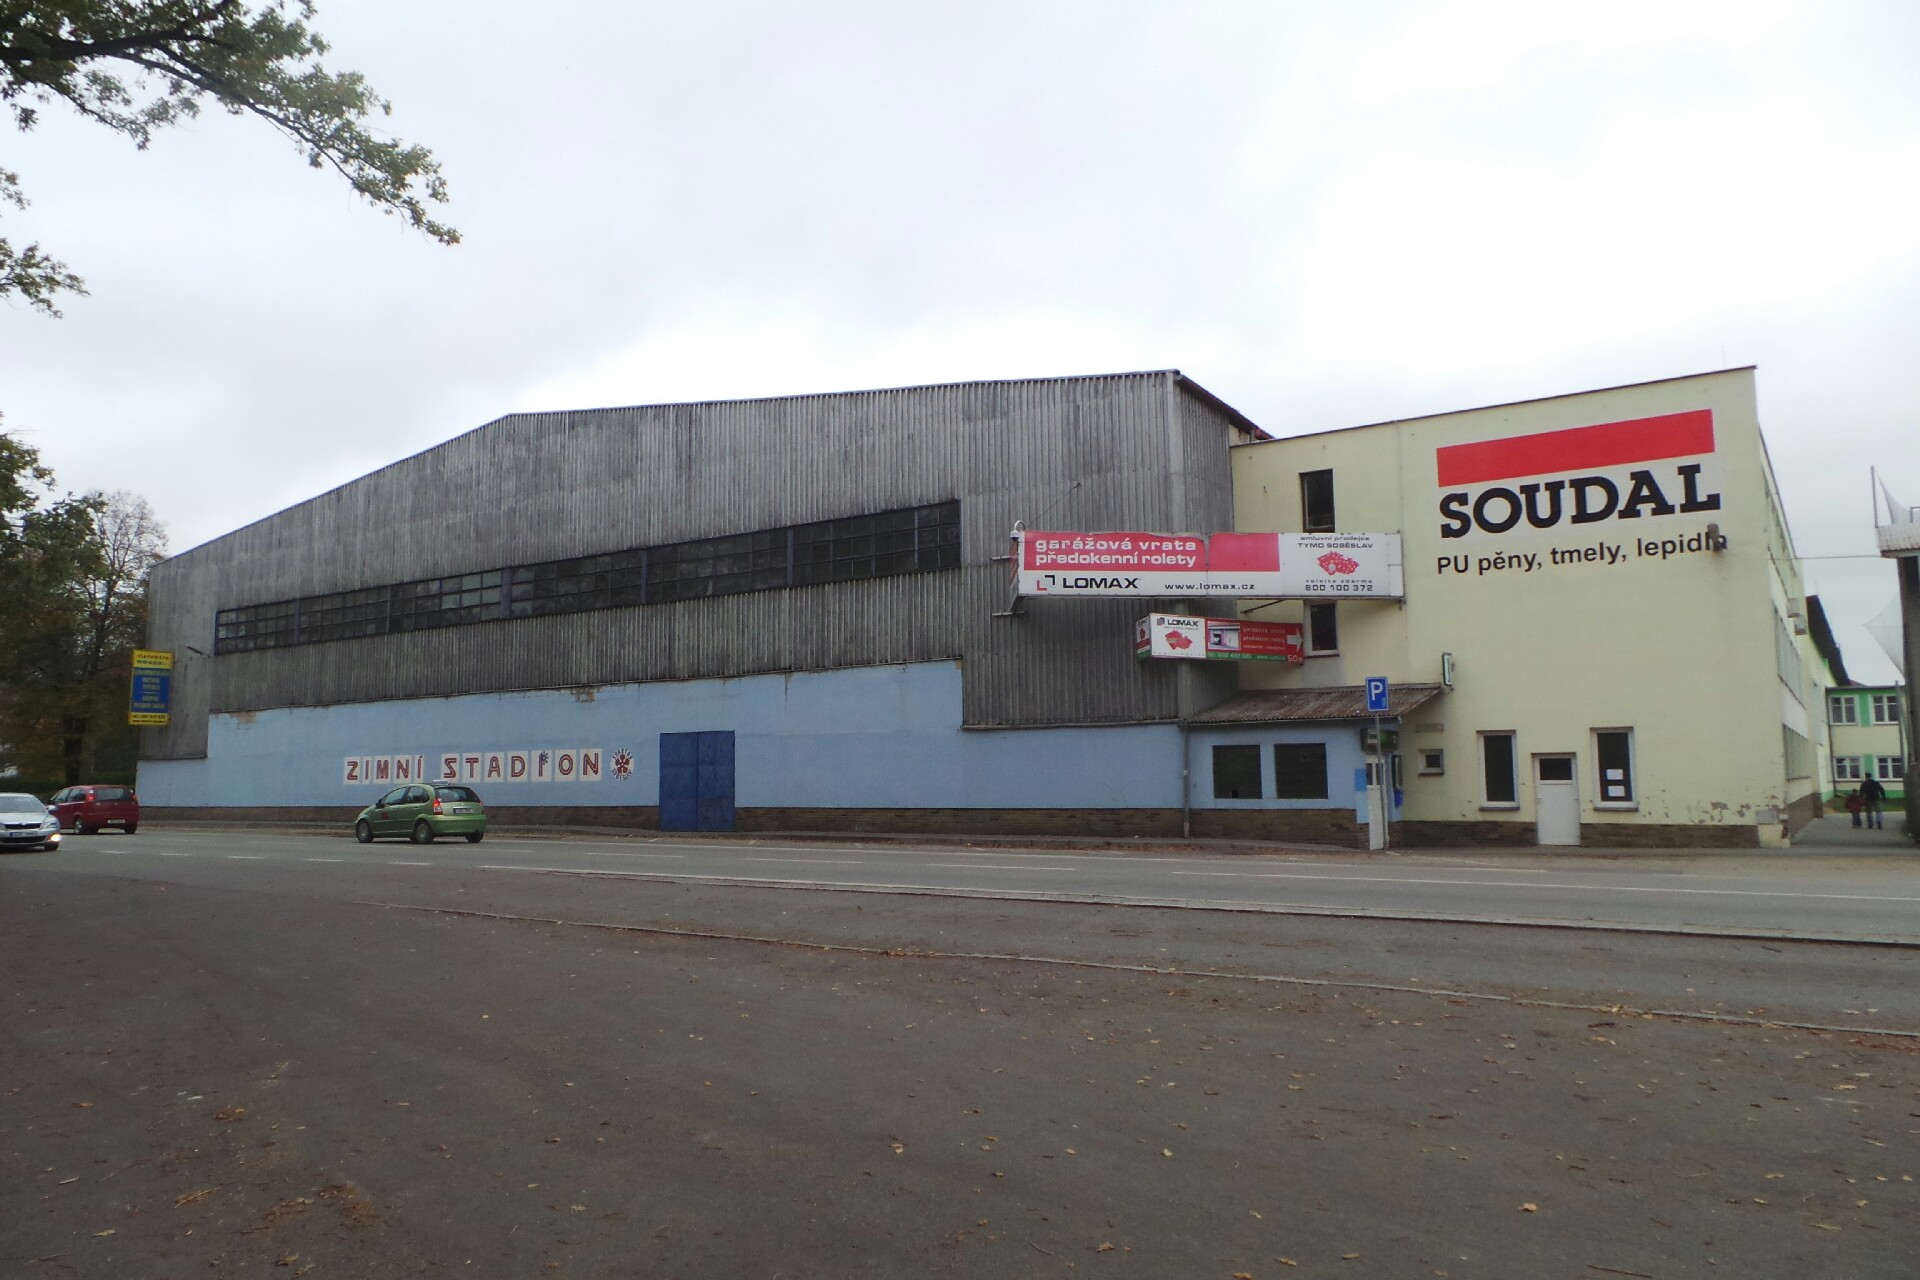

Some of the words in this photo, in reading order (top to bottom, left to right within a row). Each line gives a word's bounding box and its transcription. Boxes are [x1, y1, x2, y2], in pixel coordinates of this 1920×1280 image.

[1439, 463, 1721, 539] SOUDAL
[1035, 537, 1132, 552] garážová
[1139, 540, 1196, 550] vrata
[1035, 551, 1138, 565] předokenní
[1141, 552, 1196, 567] rolety
[1437, 554, 1469, 575] PU
[1478, 551, 1542, 576] pěny,
[1550, 541, 1627, 566] tmely,
[1062, 577, 1139, 589] LOMAX
[1164, 582, 1255, 590] www.lomax.cz
[1167, 619, 1199, 627] LOMAX
[1371, 681, 1383, 701] P
[346, 754, 423, 781] ZIMNÍ
[443, 751, 599, 779] STADION
